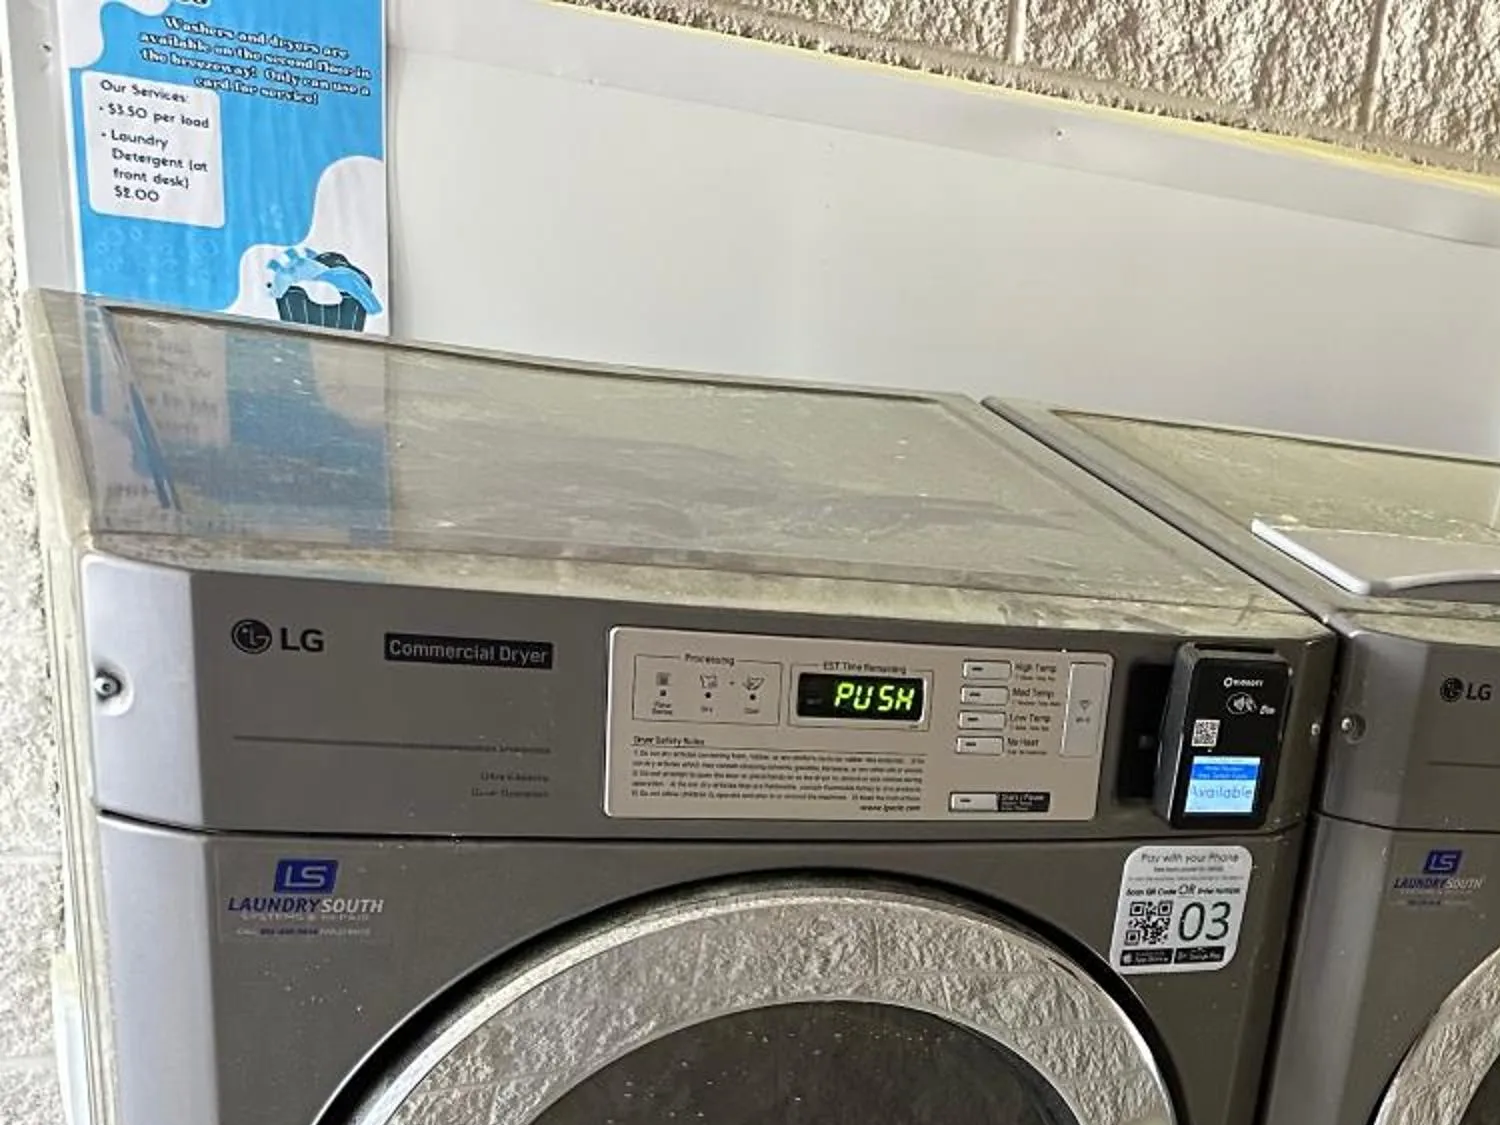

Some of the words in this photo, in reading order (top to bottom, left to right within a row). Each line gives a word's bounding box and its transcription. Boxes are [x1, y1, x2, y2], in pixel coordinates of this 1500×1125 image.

[164, 16, 235, 39] Washers
[237, 31, 265, 46] and
[269, 34, 320, 55] dryers
[322, 46, 350, 61] are
[139, 32, 208, 53] available
[213, 44, 235, 57] on
[236, 44, 261, 62] the
[264, 53, 315, 71] second
[141, 49, 168, 65] the
[170, 52, 257, 79] breezeway!
[264, 68, 299, 87] Only
[100, 79, 126, 93] Our
[131, 84, 189, 102] Services:
[194, 77, 232, 92] card
[233, 79, 258, 95] for
[108, 102, 148, 119] $3.50
[153, 113, 175, 124] per
[181, 114, 210, 129] load
[111, 129, 168, 151] Laundry
[111, 147, 184, 169] Detergent
[189, 159, 208, 173] (at
[113, 167, 147, 182] front
[153, 173, 189, 190] desk)
[114, 185, 160, 202] $2.00
[281, 627, 325, 652] LG
[389, 639, 495, 662] Commercial
[500, 642, 549, 664] Dryer
[685, 652, 735, 667] Processing
[835, 682, 915, 712] PUSH
[1466, 682, 1493, 702] LG
[1141, 852, 1160, 864] Pay
[1162, 852, 1184, 863] with
[1185, 854, 1206, 865] your
[1209, 852, 1240, 863] Phone
[1428, 853, 1457, 871] LS
[1178, 901, 1231, 942] 03
